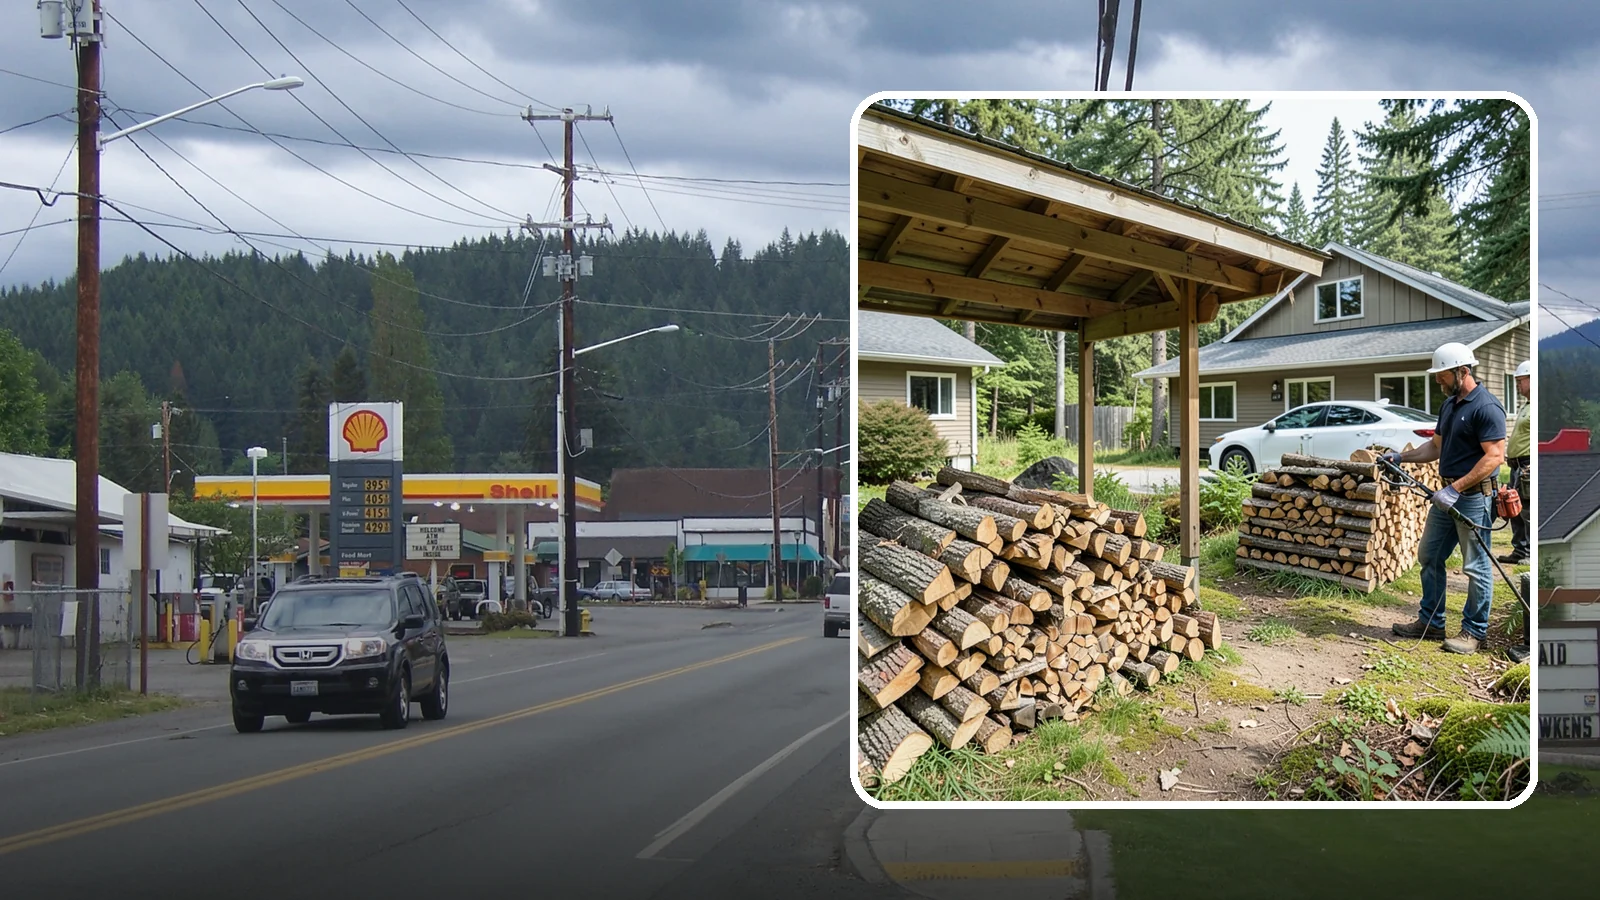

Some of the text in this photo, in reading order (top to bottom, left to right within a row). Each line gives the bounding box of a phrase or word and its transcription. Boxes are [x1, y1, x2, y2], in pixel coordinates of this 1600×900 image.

[366, 480, 383, 490] 395
[490, 484, 547, 499] Shell
[366, 494, 383, 504] 405
[366, 508, 383, 518] 415
[366, 522, 383, 532] 429
